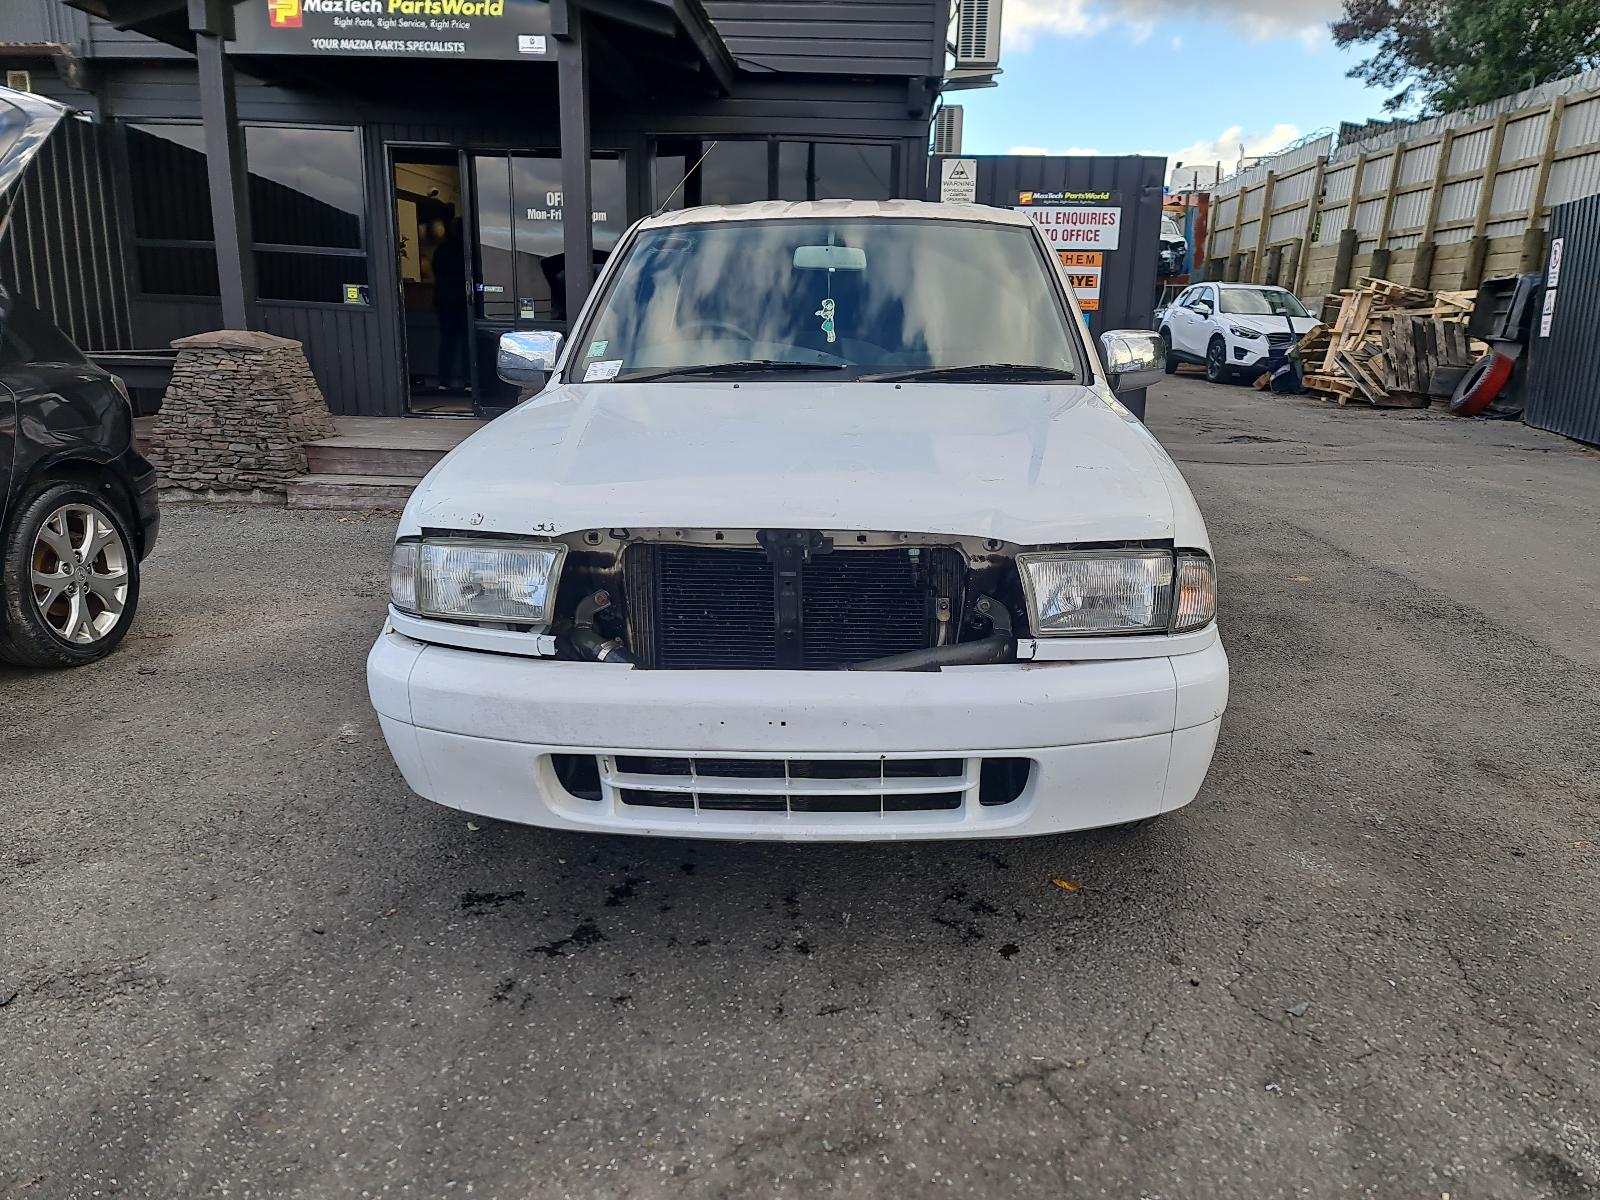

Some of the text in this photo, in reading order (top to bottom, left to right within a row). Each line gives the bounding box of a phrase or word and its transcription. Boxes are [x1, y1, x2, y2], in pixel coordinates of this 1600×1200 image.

[303, 0, 504, 16] MazTech PartsWorld
[333, 17, 471, 30] Right Parts, Right Service, Right Price
[312, 38, 465, 52] YOUR MAZDA PARTS SPECIALISTS
[546, 191, 564, 207] OF
[1064, 192, 1110, 200] PartsWorld
[527, 208, 562, 220] Mon-Fri
[1032, 212, 1116, 226] ALL ENQUIRIES
[1045, 228, 1101, 242] TO OFFICE
